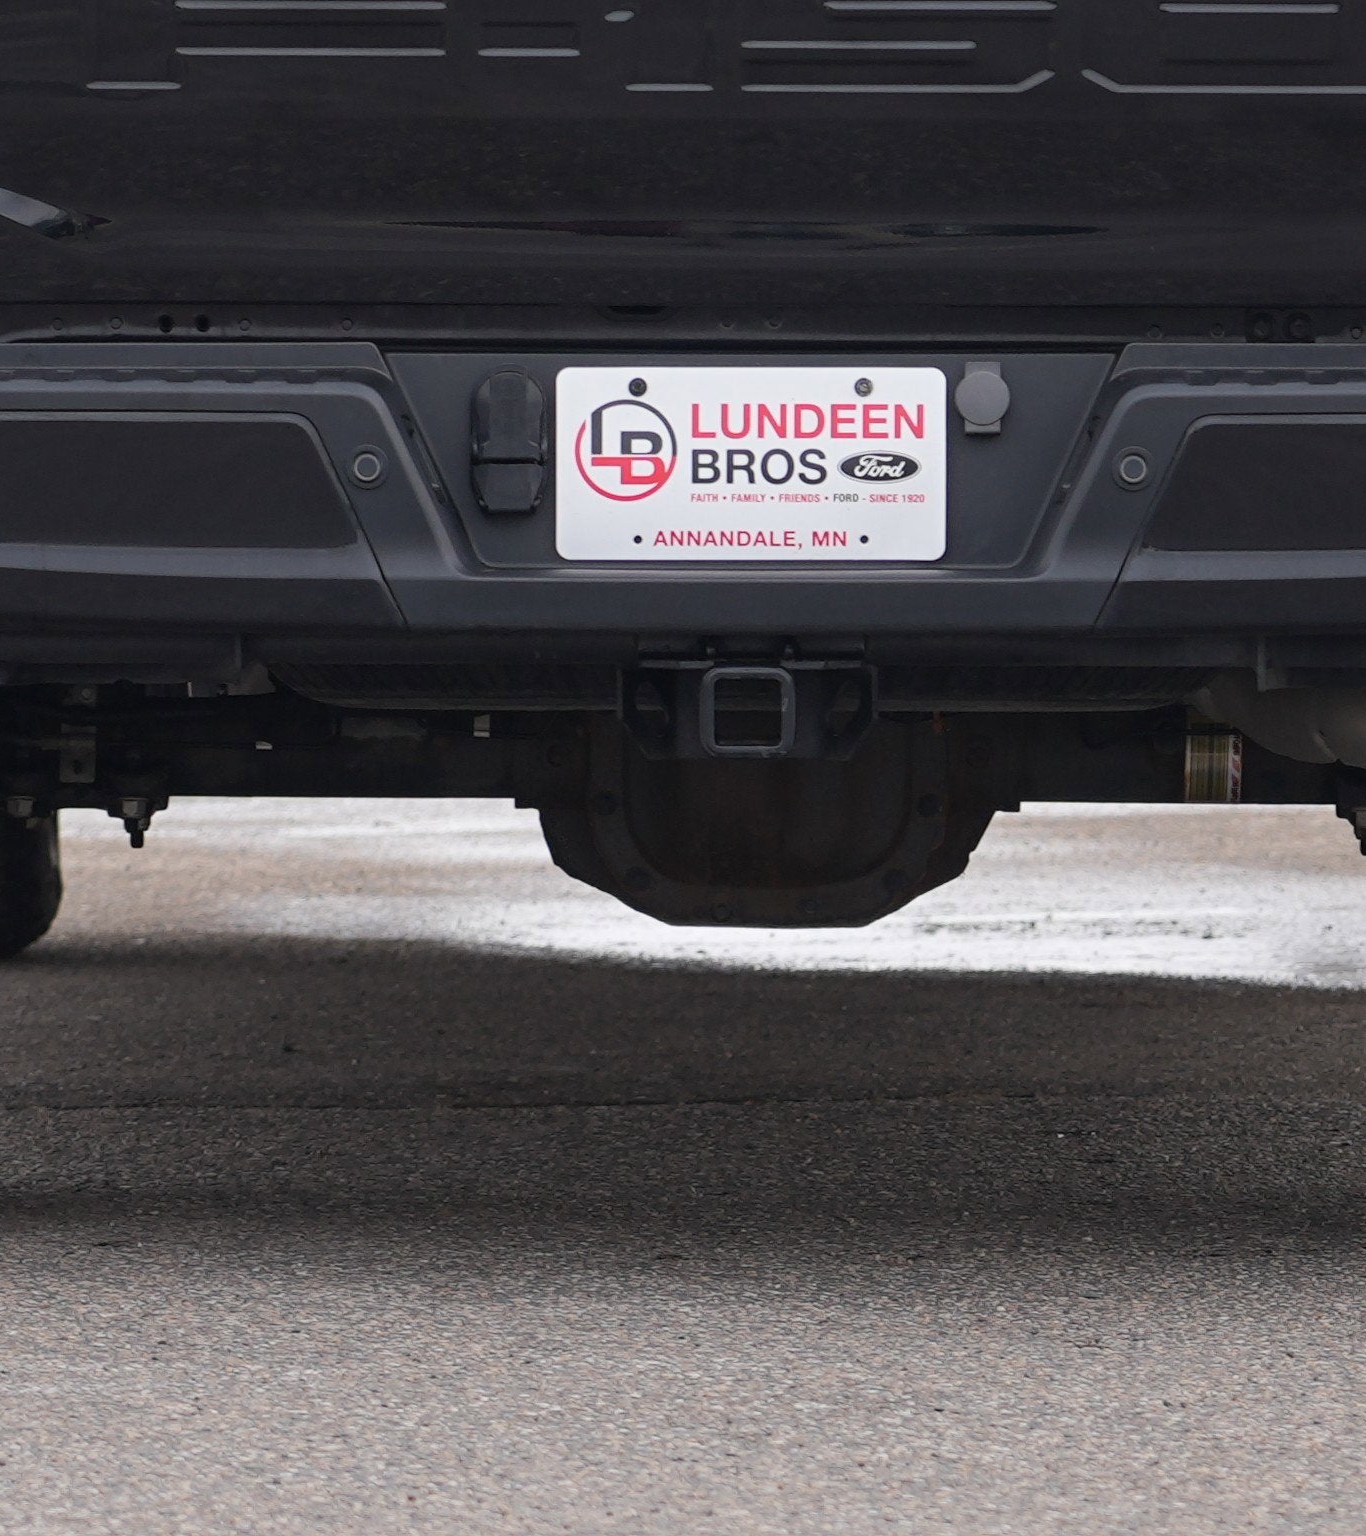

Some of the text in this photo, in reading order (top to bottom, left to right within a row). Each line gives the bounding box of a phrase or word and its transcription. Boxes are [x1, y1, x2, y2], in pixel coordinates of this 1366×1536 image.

[690, 403, 925, 440] LUNDEEN
[690, 448, 828, 486] BROS
[853, 457, 906, 480] Ford
[690, 493, 925, 503] FAITH FAMILY FRIENDS FORD SINCE 1920
[653, 530, 848, 550] ANNANDALE, MN
